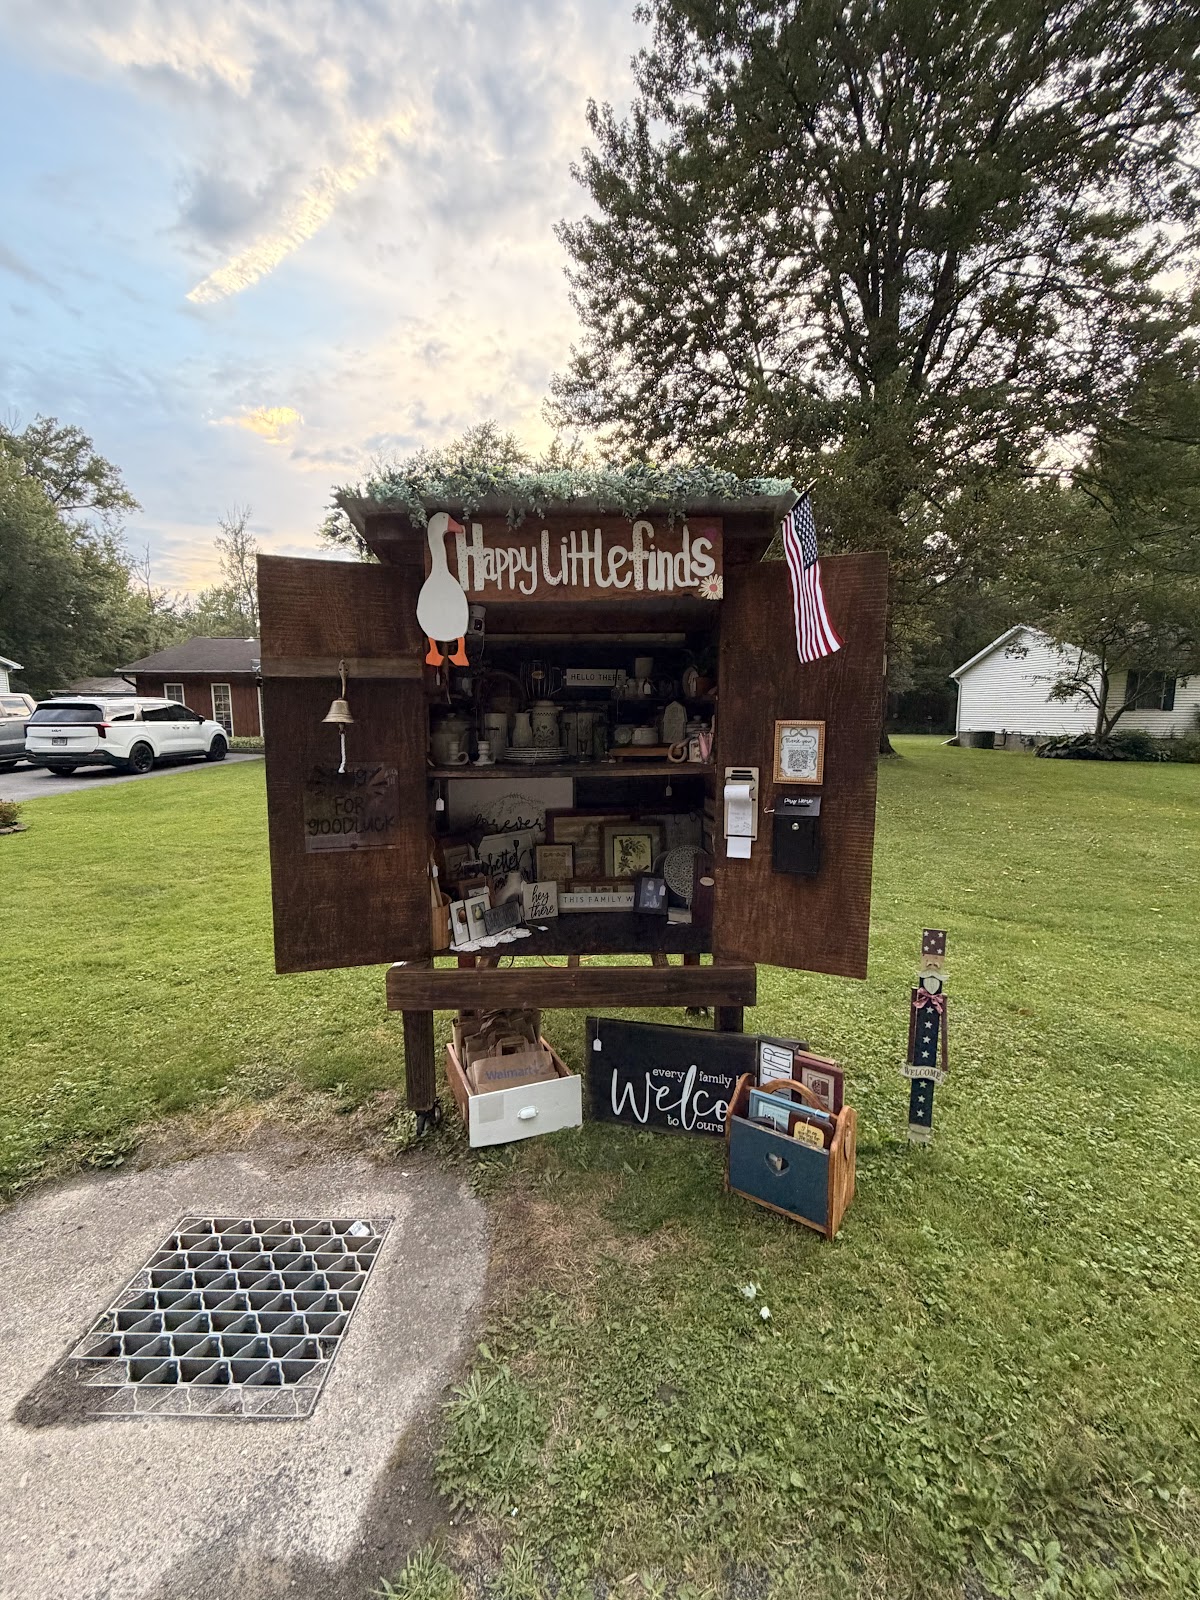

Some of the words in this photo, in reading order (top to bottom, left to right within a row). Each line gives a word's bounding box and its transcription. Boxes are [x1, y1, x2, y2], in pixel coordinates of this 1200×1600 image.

[456, 522, 537, 595] Happy
[541, 528, 633, 589] Little
[628, 520, 716, 591] finds
[570, 673, 595, 681] HELLO
[599, 673, 622, 681] THERE
[334, 796, 365, 815] FOR
[784, 797, 798, 805] Pay
[531, 884, 550, 906] hey
[563, 896, 584, 904] THIS
[528, 902, 555, 919] there
[486, 1066, 533, 1080] Walmart
[652, 1068, 686, 1083] every
[698, 1071, 733, 1088] family
[904, 1065, 942, 1081] WELCOME
[667, 1114, 680, 1126] to
[696, 1121, 724, 1132] ours
